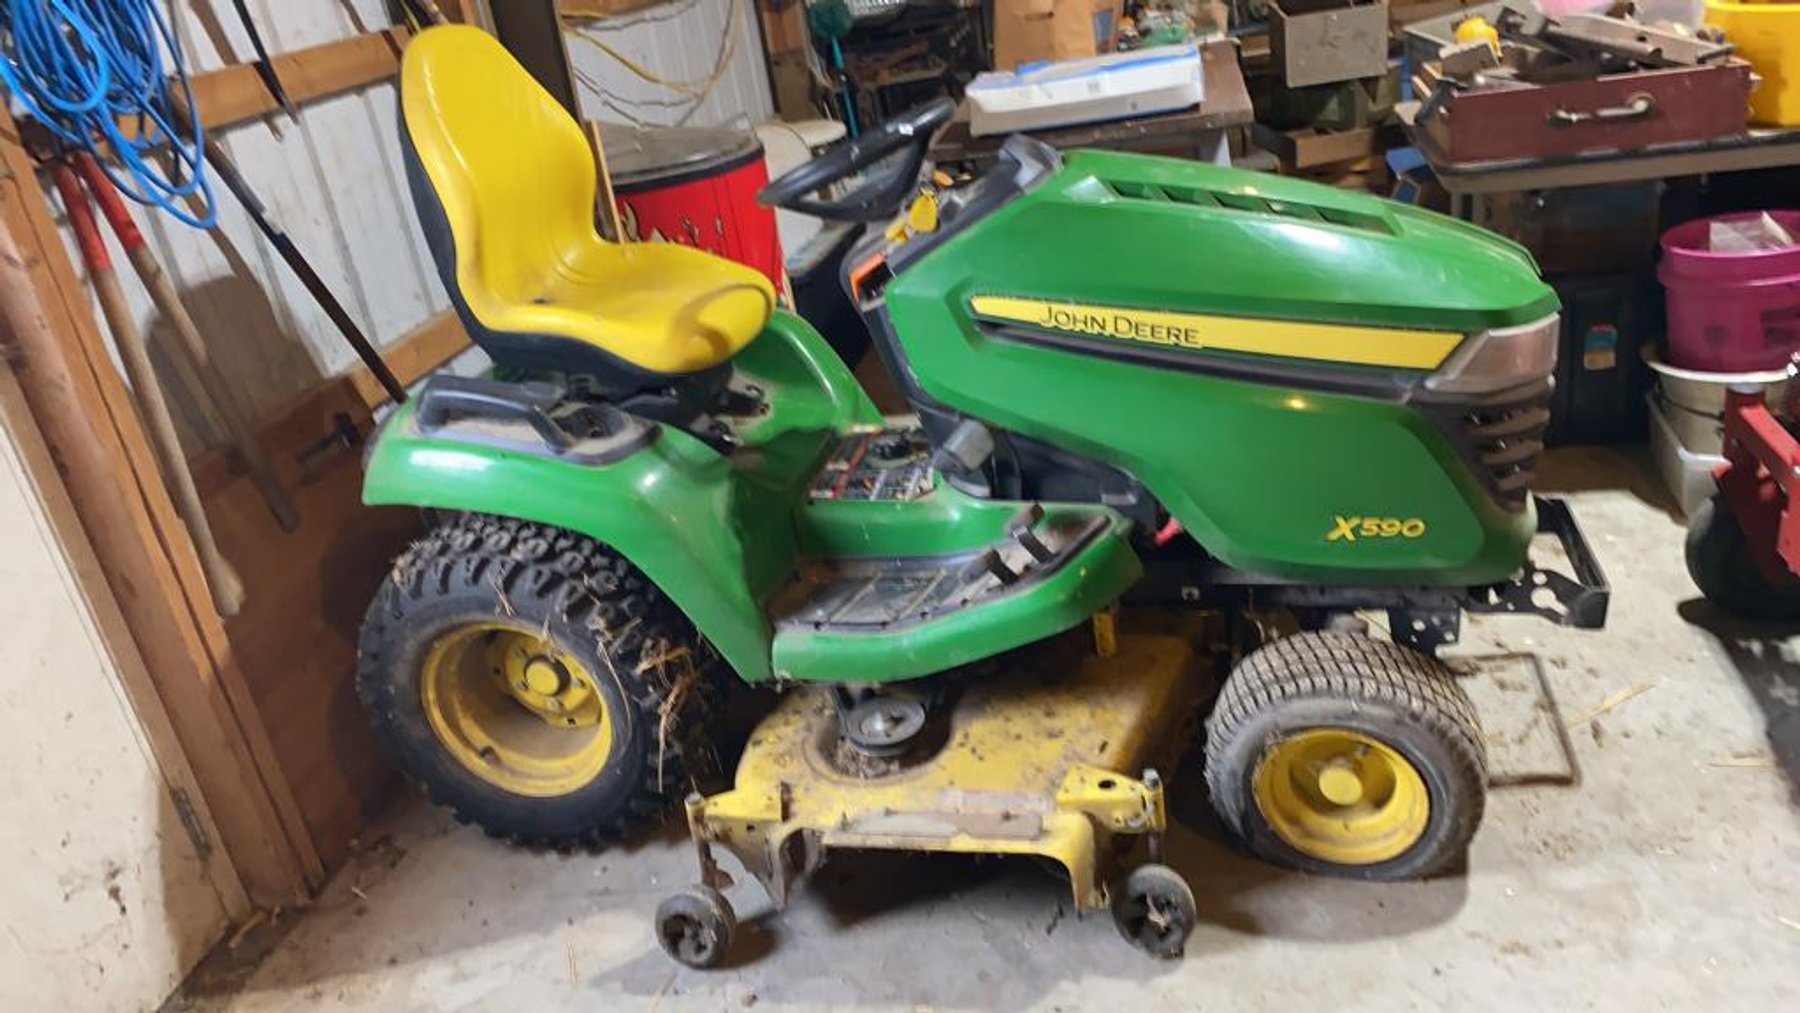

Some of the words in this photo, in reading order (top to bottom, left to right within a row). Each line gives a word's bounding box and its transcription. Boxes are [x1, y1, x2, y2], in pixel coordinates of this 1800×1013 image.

[1040, 305, 1107, 332] JOHN
[1114, 315, 1200, 345] DEERE
[1326, 515, 1426, 541] X590
